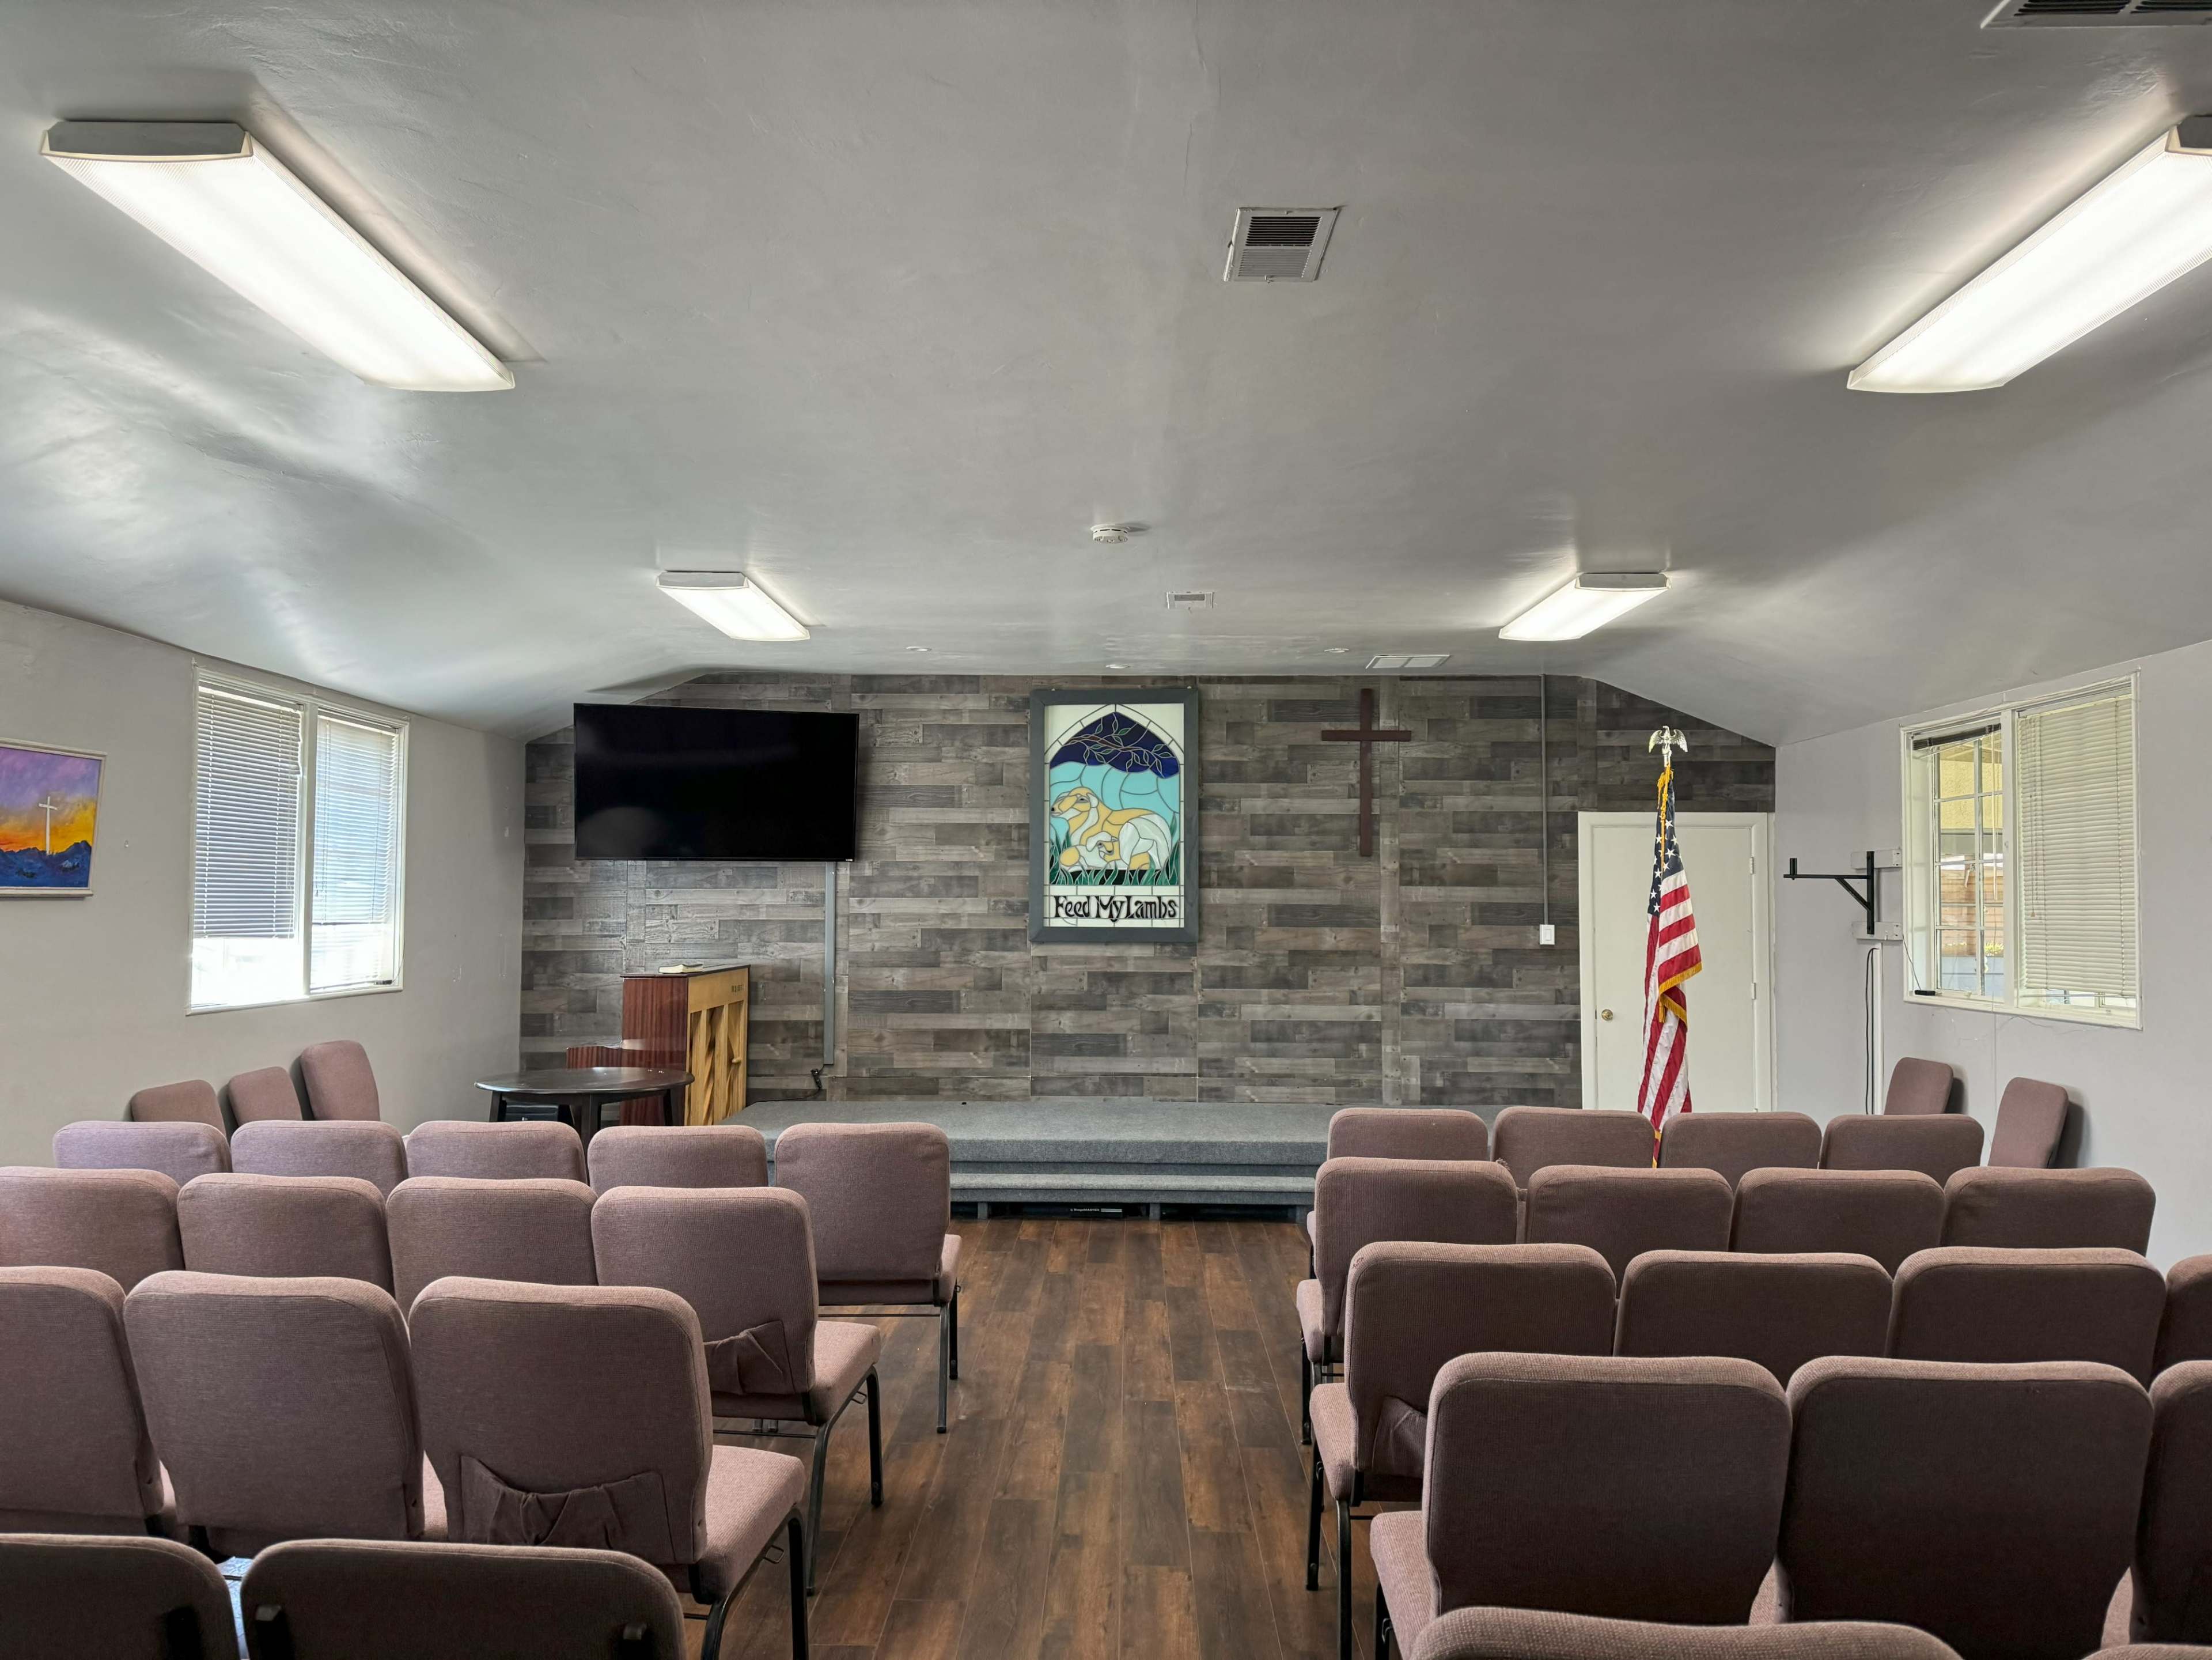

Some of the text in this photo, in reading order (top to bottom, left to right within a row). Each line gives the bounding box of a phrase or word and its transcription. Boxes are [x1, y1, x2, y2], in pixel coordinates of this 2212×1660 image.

[1054, 895, 1179, 922] Feed My Lambs
